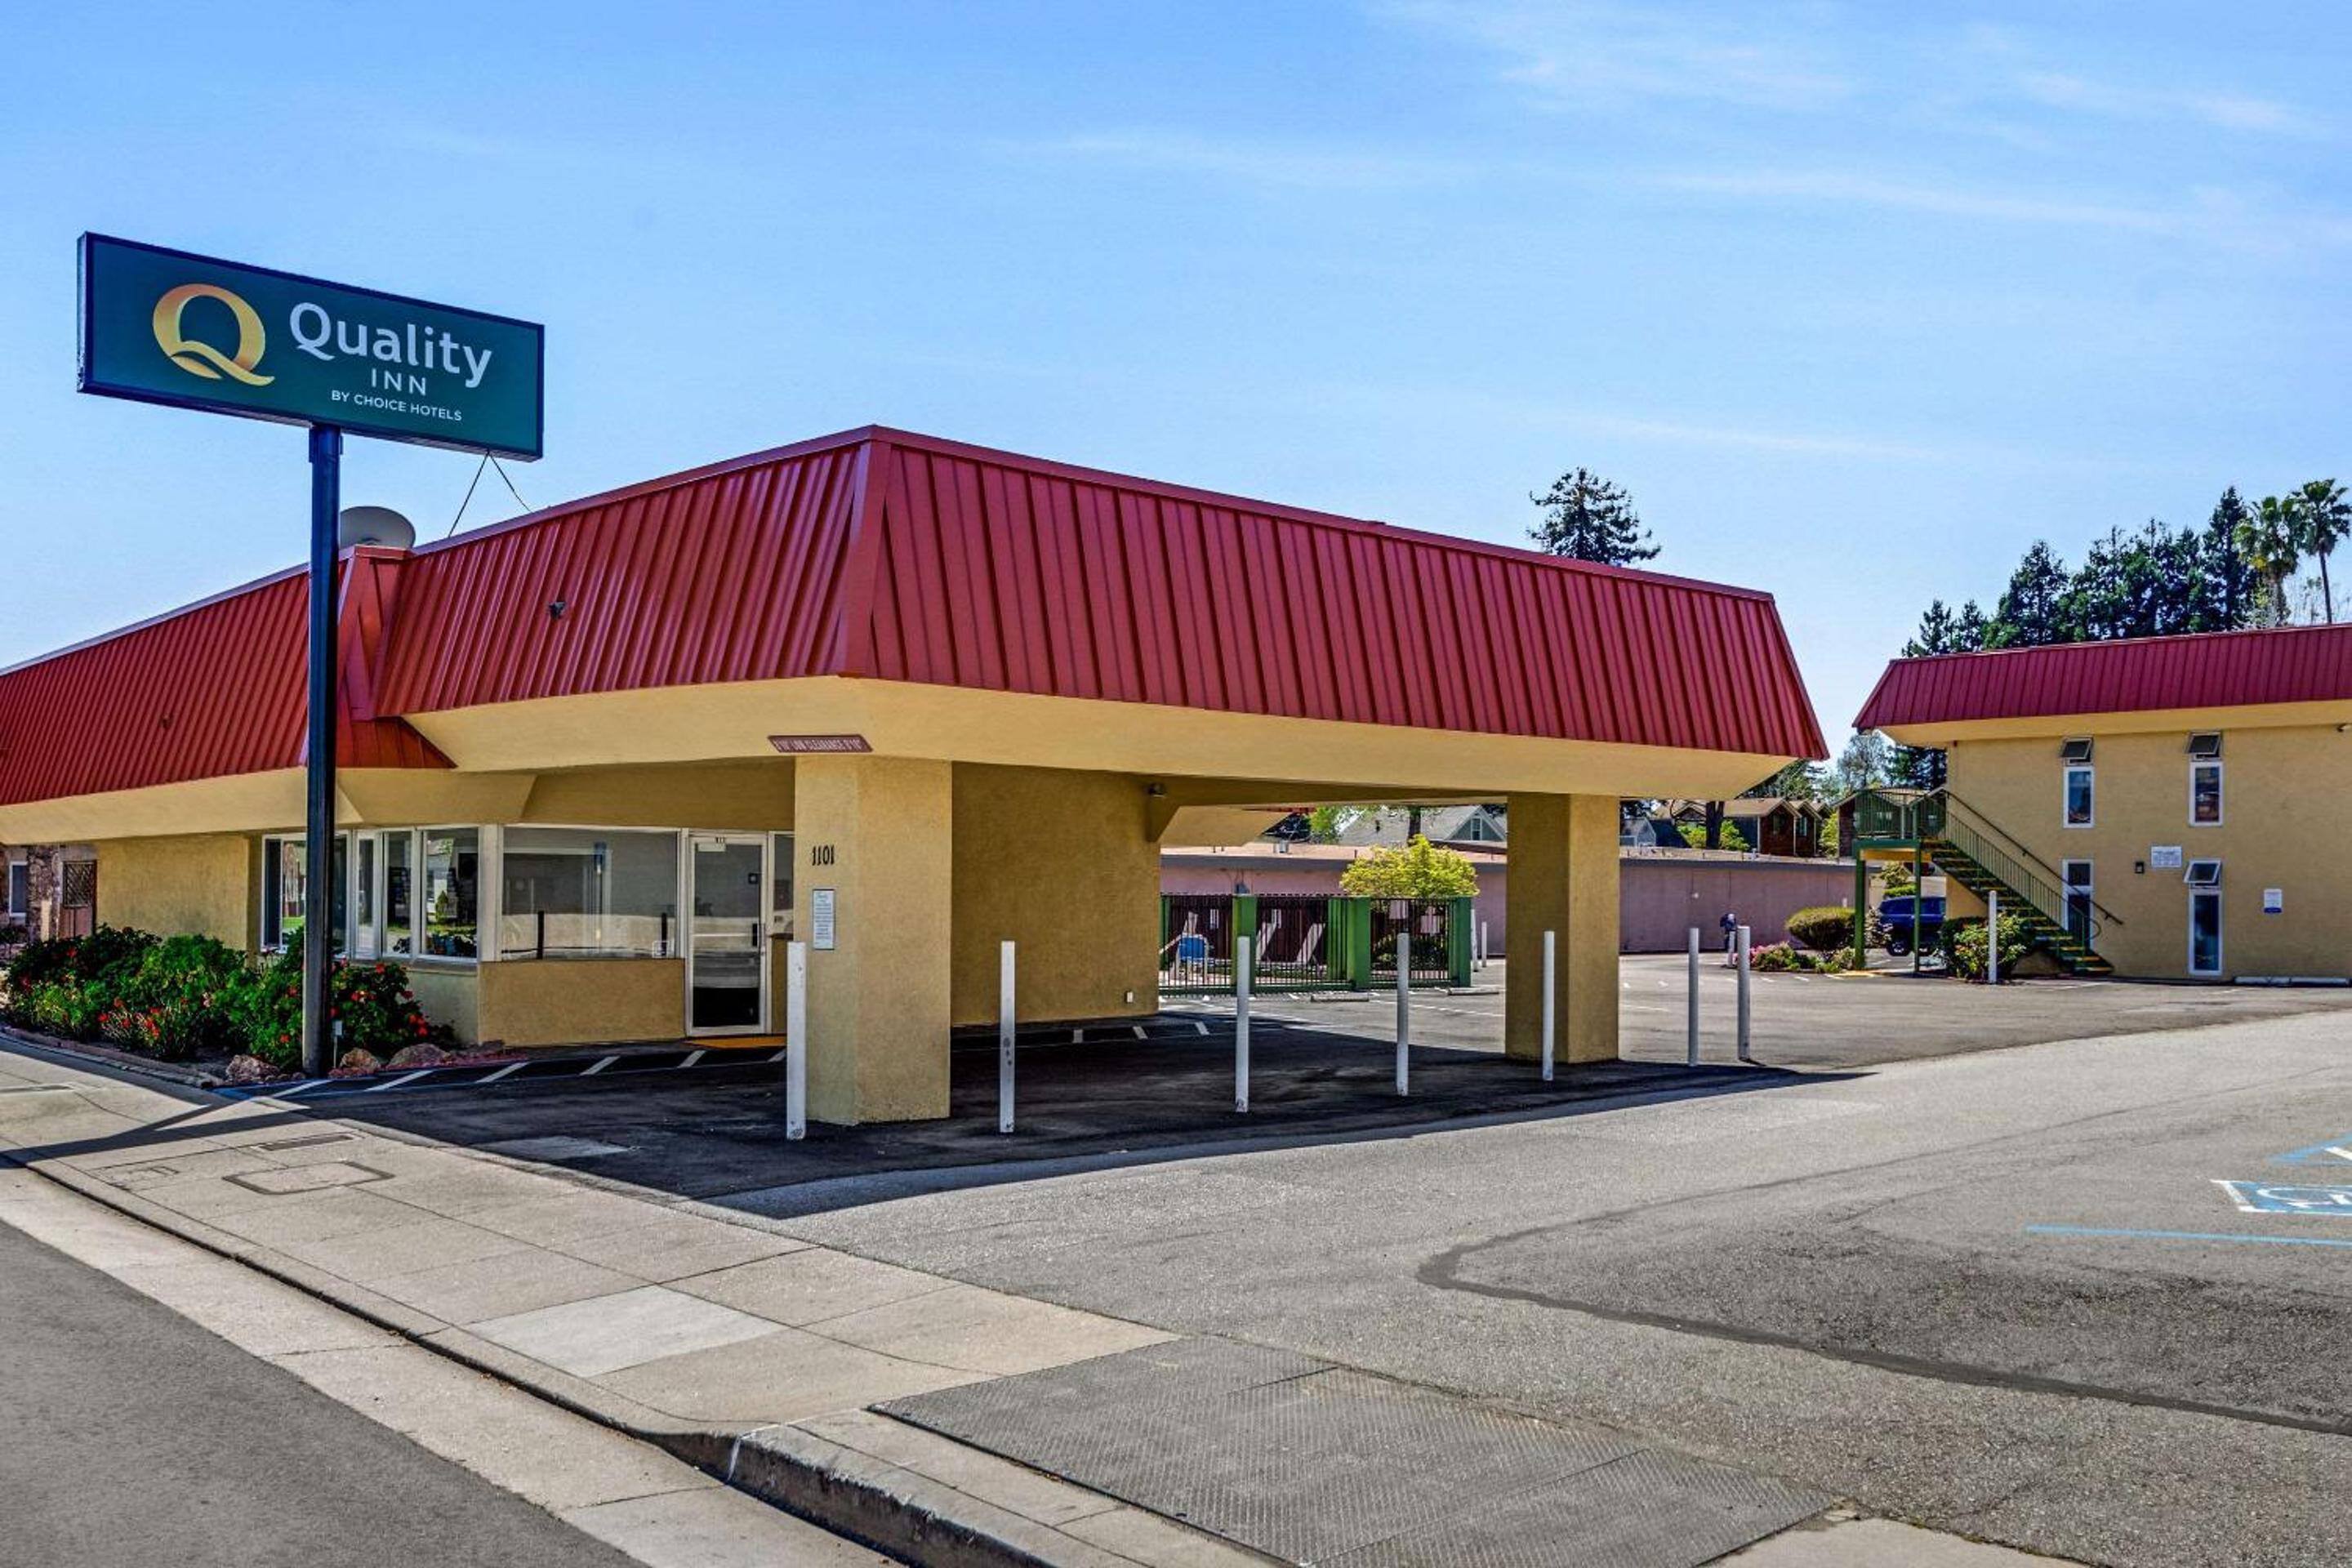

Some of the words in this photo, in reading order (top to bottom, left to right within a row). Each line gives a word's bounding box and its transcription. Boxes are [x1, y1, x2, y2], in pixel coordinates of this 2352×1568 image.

[153, 283, 274, 386] Q
[289, 302, 492, 388] Quality
[372, 368, 426, 396] INN
[332, 390, 350, 403] BY
[354, 394, 407, 412] CHOICE
[410, 403, 462, 421] HOTELS
[812, 844, 835, 866] 1101
